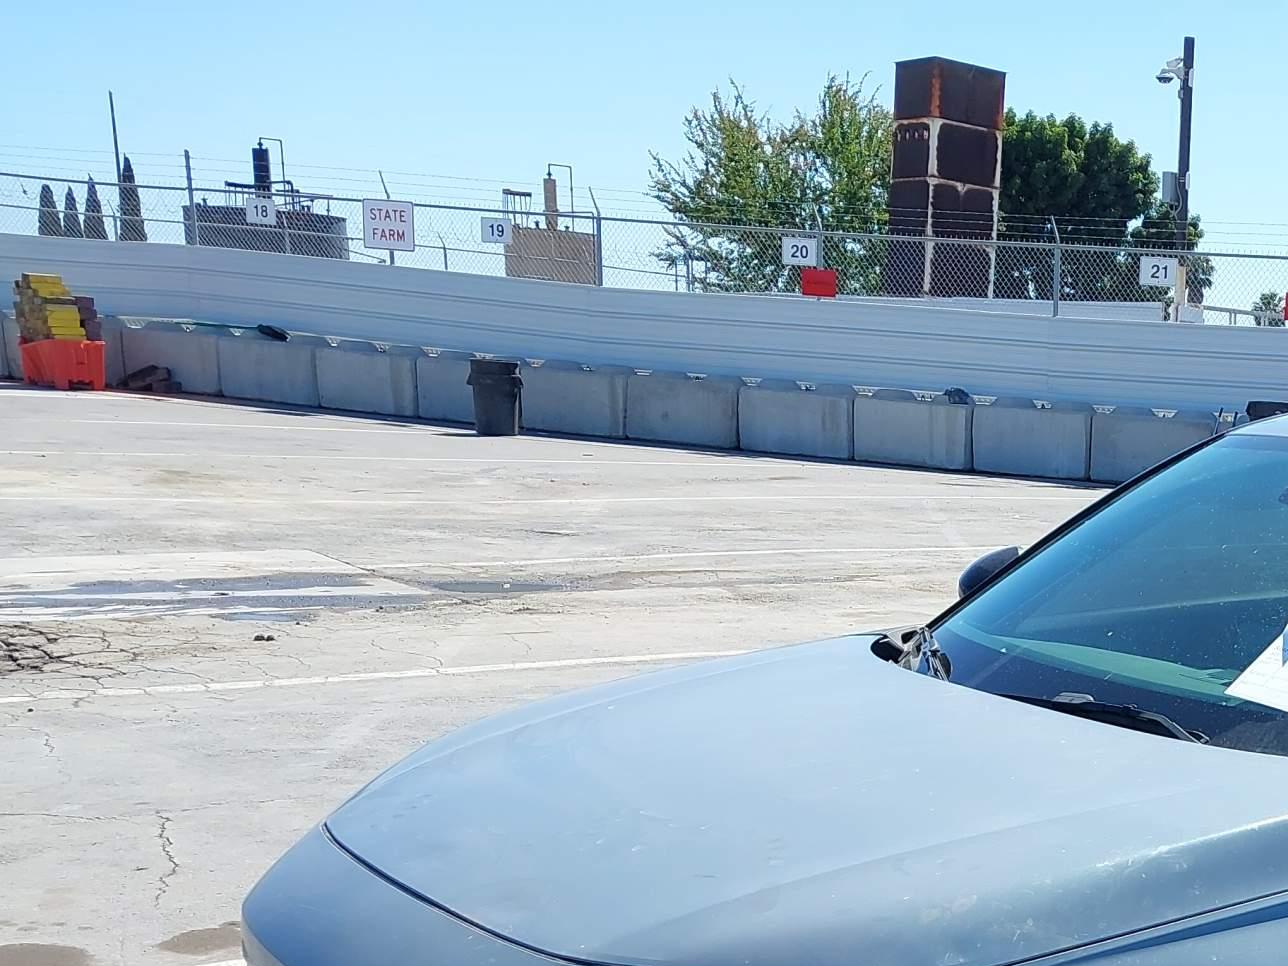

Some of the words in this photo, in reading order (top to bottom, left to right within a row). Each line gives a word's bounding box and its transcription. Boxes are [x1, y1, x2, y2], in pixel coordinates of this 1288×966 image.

[253, 204, 268, 218] 18
[369, 207, 407, 223] STATE
[372, 227, 406, 242] FARM
[488, 223, 505, 238] 19
[790, 244, 809, 259] 20
[1150, 264, 1168, 280] 21
